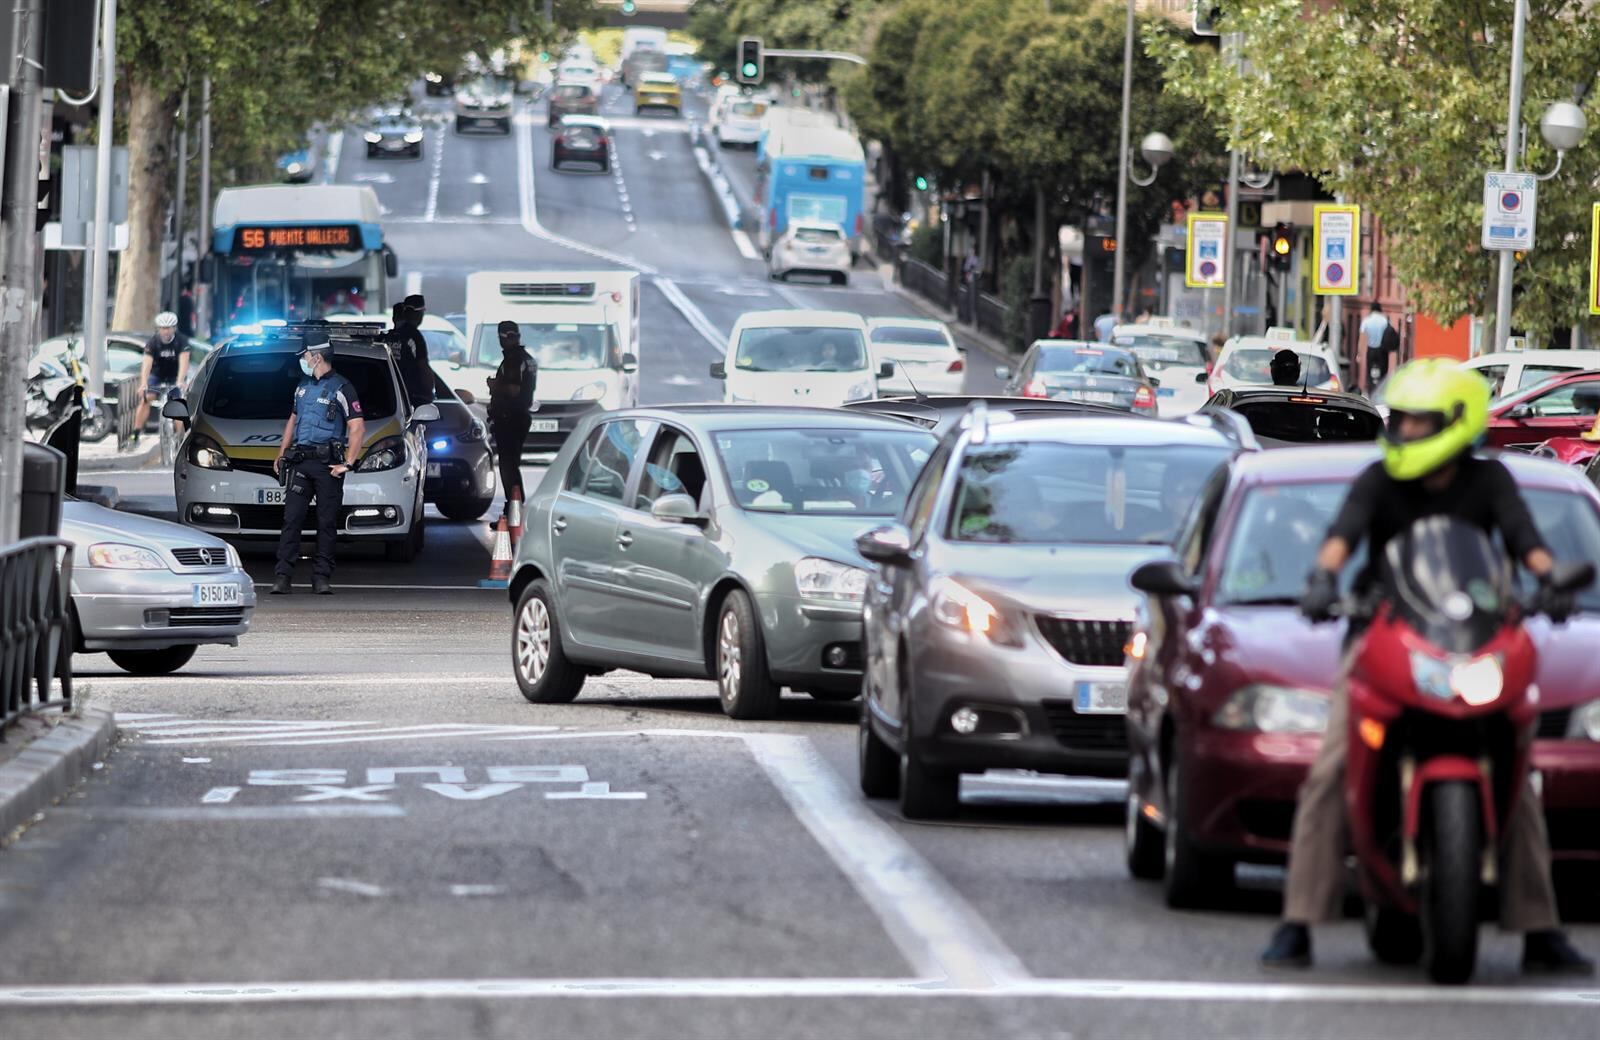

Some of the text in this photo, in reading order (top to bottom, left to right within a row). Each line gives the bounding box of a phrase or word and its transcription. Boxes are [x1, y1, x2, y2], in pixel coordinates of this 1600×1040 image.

[242, 228, 350, 248] 56 PUENTE VALLECAS
[201, 586, 222, 602] 6150
[201, 782, 648, 802] TAXI
